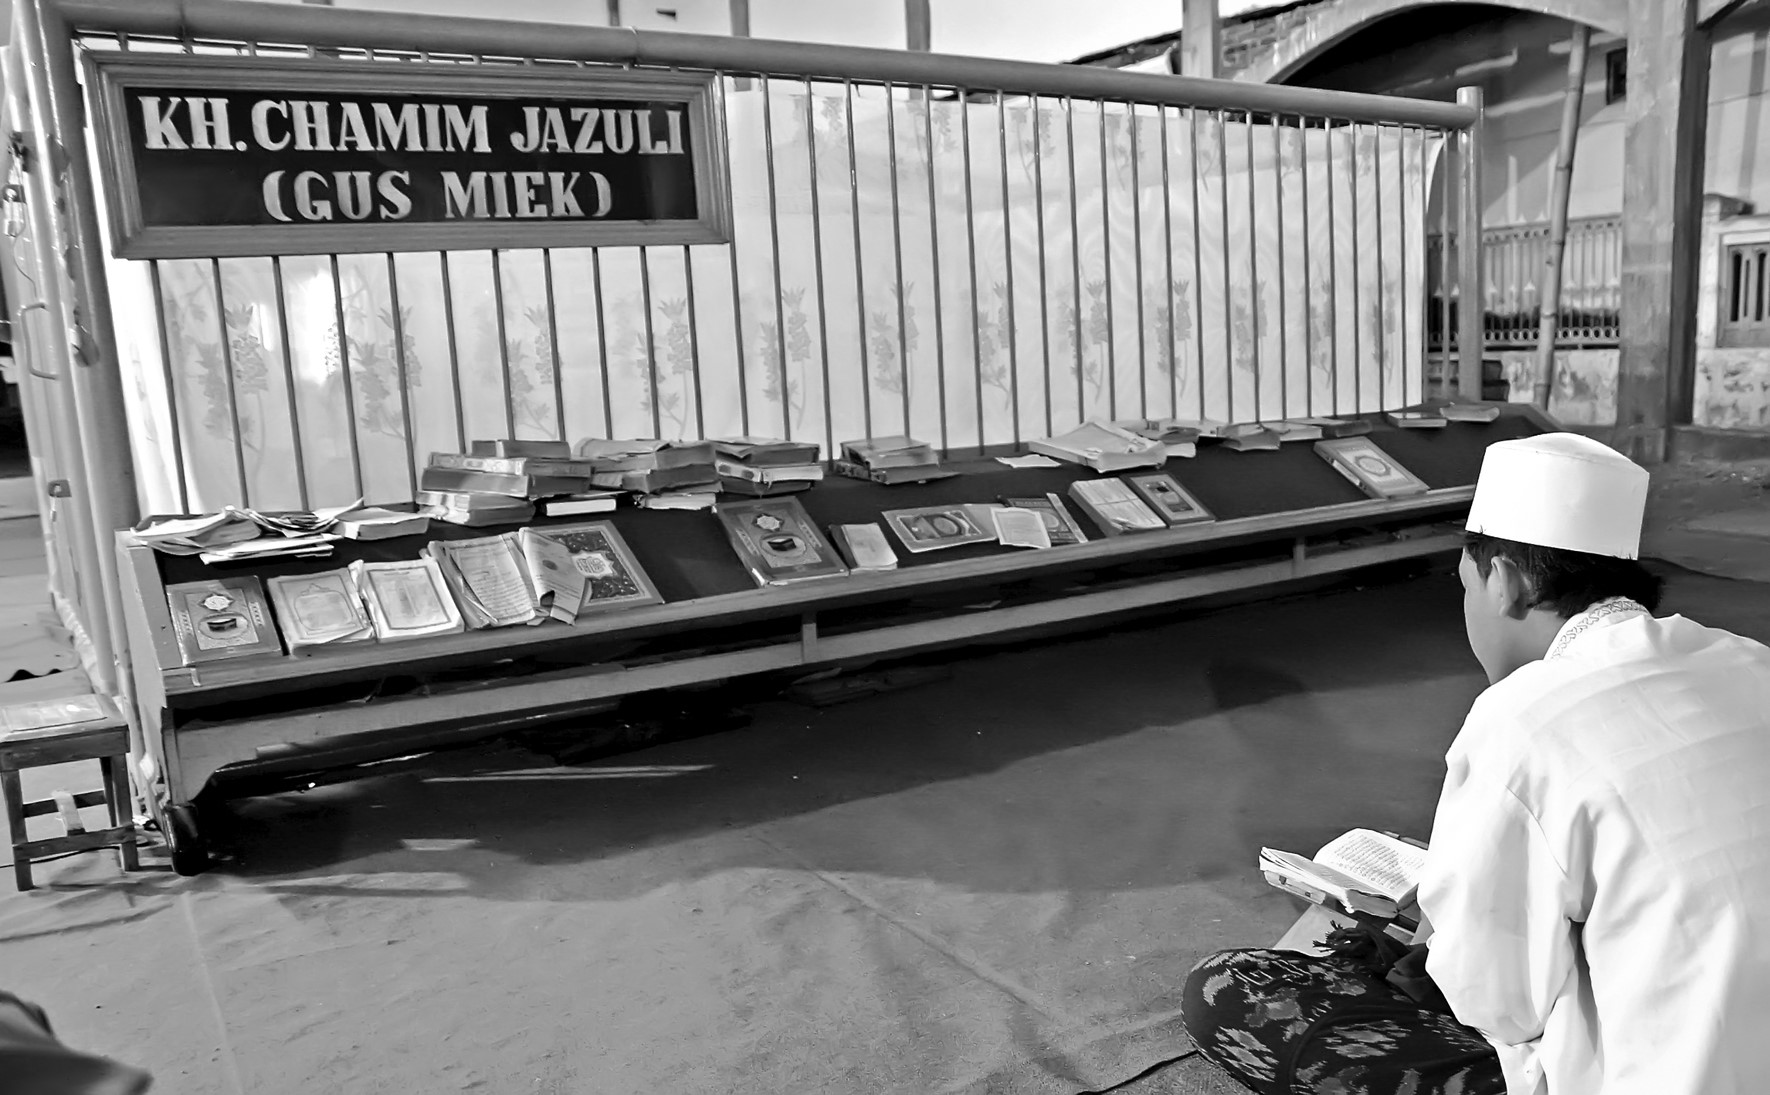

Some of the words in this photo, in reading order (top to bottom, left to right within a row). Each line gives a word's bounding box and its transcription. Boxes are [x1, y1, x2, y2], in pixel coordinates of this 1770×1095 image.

[510, 105, 685, 156] JAZULI
[263, 171, 412, 221] (GUS
[440, 171, 611, 219] MIEK)
